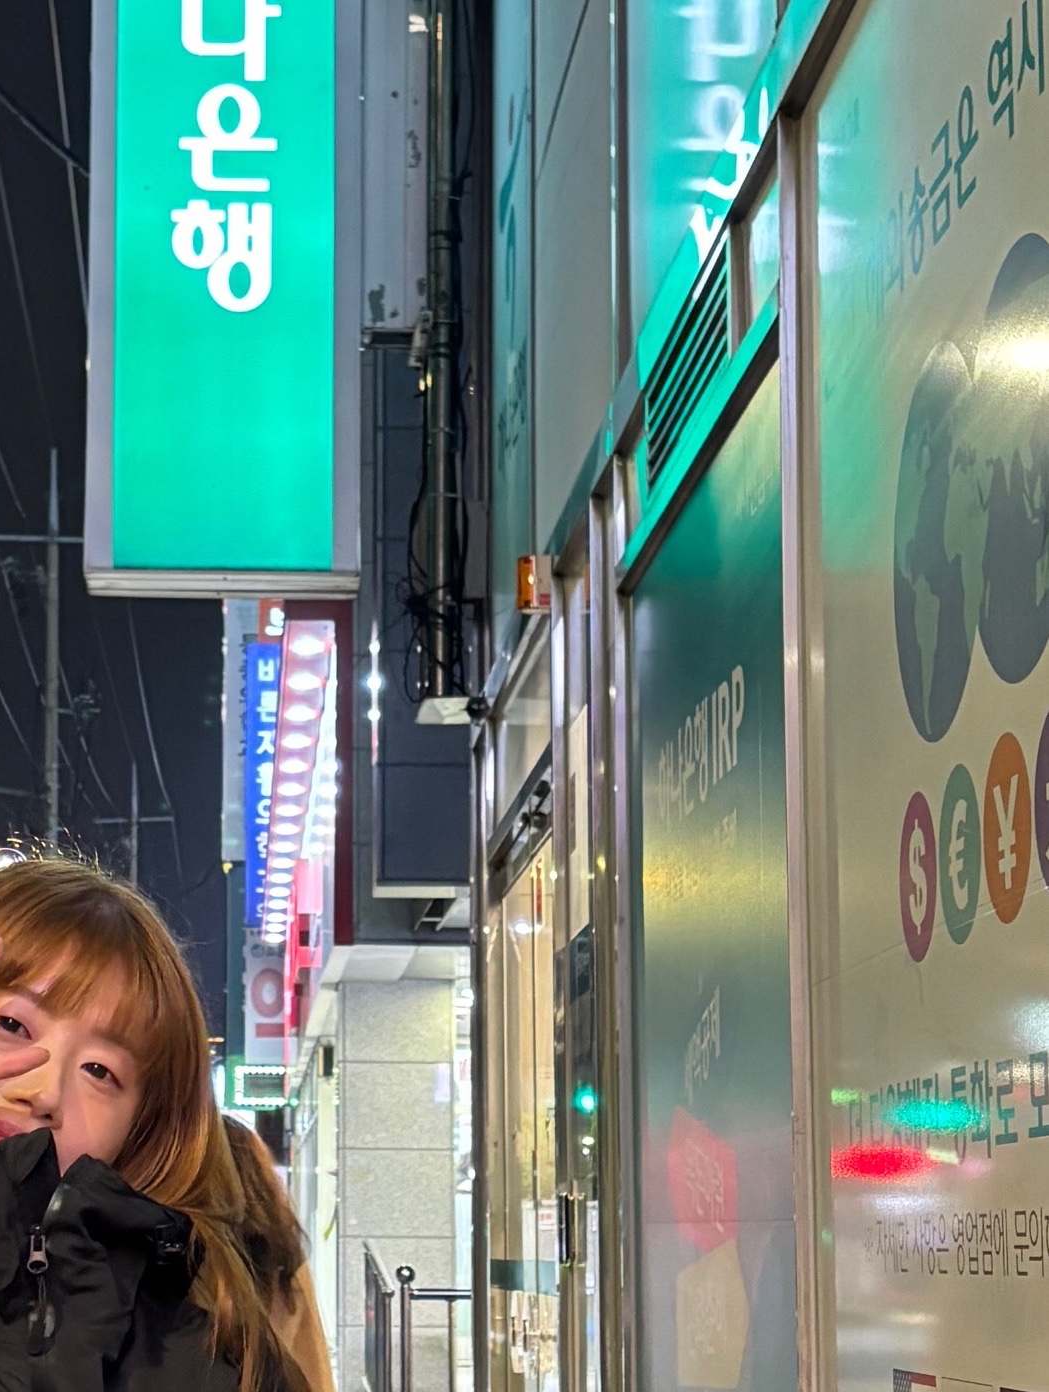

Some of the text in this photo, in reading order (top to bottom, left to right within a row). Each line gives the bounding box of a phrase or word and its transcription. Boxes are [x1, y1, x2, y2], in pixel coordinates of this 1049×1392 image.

[712, 664, 746, 787] IRP
[876, 1214, 909, 1274] 자세한
[913, 1214, 949, 1276] 사항은
[951, 1208, 1010, 1277] 영업점에
